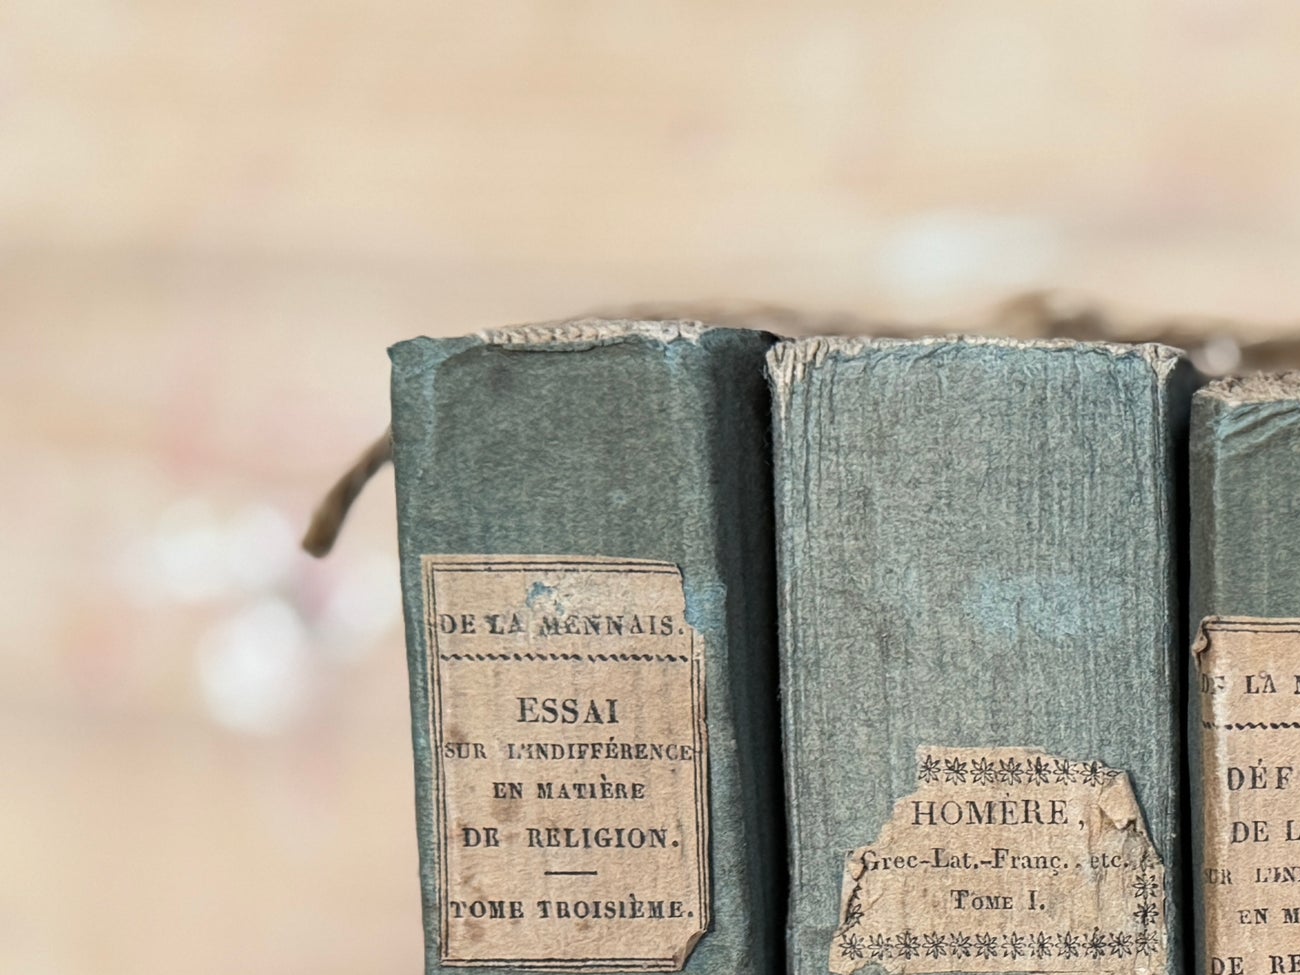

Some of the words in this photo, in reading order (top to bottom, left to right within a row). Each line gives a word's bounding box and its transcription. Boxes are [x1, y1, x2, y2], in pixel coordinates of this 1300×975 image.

[439, 613, 476, 635] DE
[1245, 673, 1277, 695] LA
[516, 696, 620, 724] ESSAI
[444, 743, 487, 760] SUR
[507, 736, 693, 761] L'INDIFFÉRENCE
[492, 782, 524, 800] EN
[537, 774, 645, 800] MATIÈRE
[911, 793, 1086, 830] HOMÈRE,
[463, 828, 499, 848] DE
[528, 827, 680, 849] RELIGION.
[1231, 820, 1269, 844] DE
[451, 900, 525, 919] TOME
[538, 893, 695, 920] TROISIÈME.
[950, 889, 1014, 911] TOME
[1027, 889, 1046, 911] I.
[1238, 908, 1269, 925] EN
[1210, 956, 1244, 975] DE
